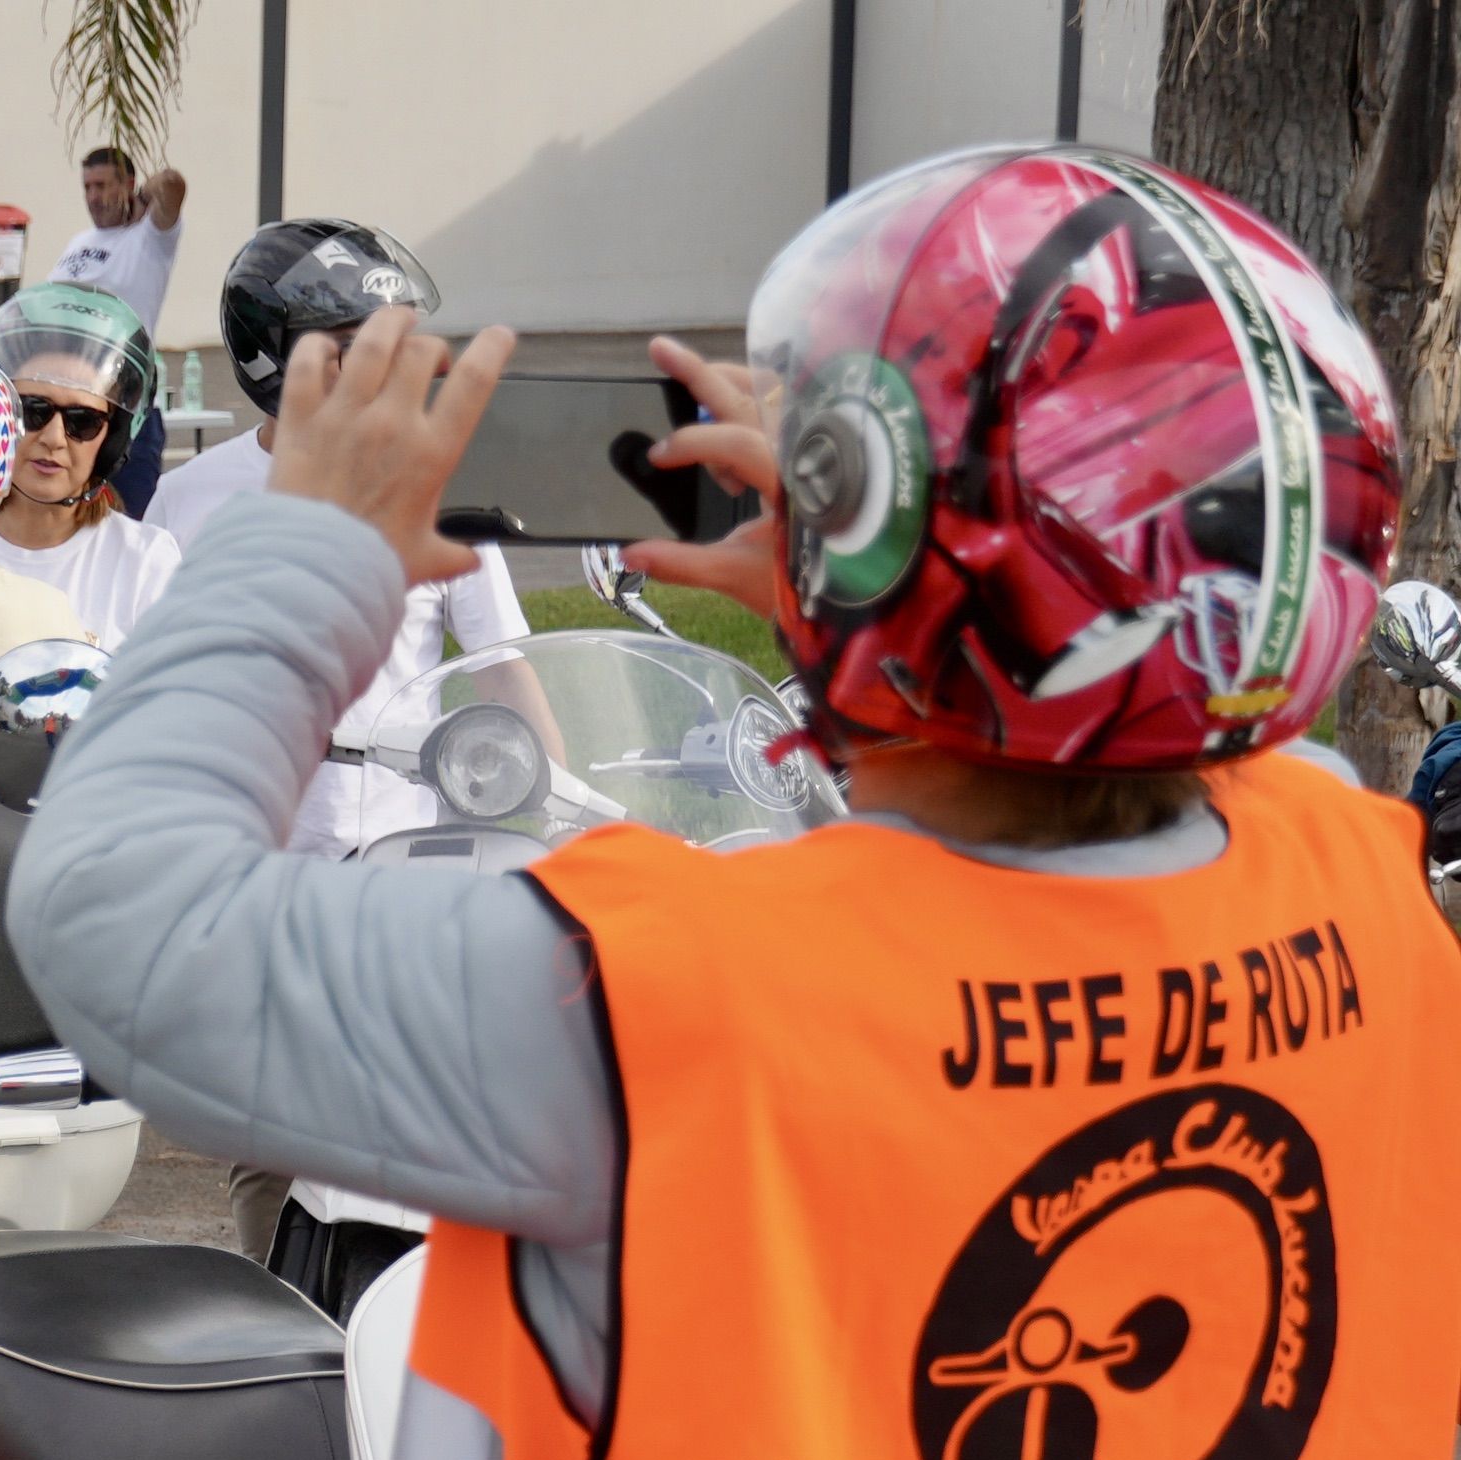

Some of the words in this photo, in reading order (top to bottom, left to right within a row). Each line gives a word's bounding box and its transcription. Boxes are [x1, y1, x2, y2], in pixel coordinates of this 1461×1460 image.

[941, 973, 1126, 1091] JEFE
[1149, 960, 1231, 1080] DE
[1237, 919, 1365, 1061] RUTA
[1011, 1137, 1158, 1256] Vespa
[1160, 1098, 1288, 1198] Club
